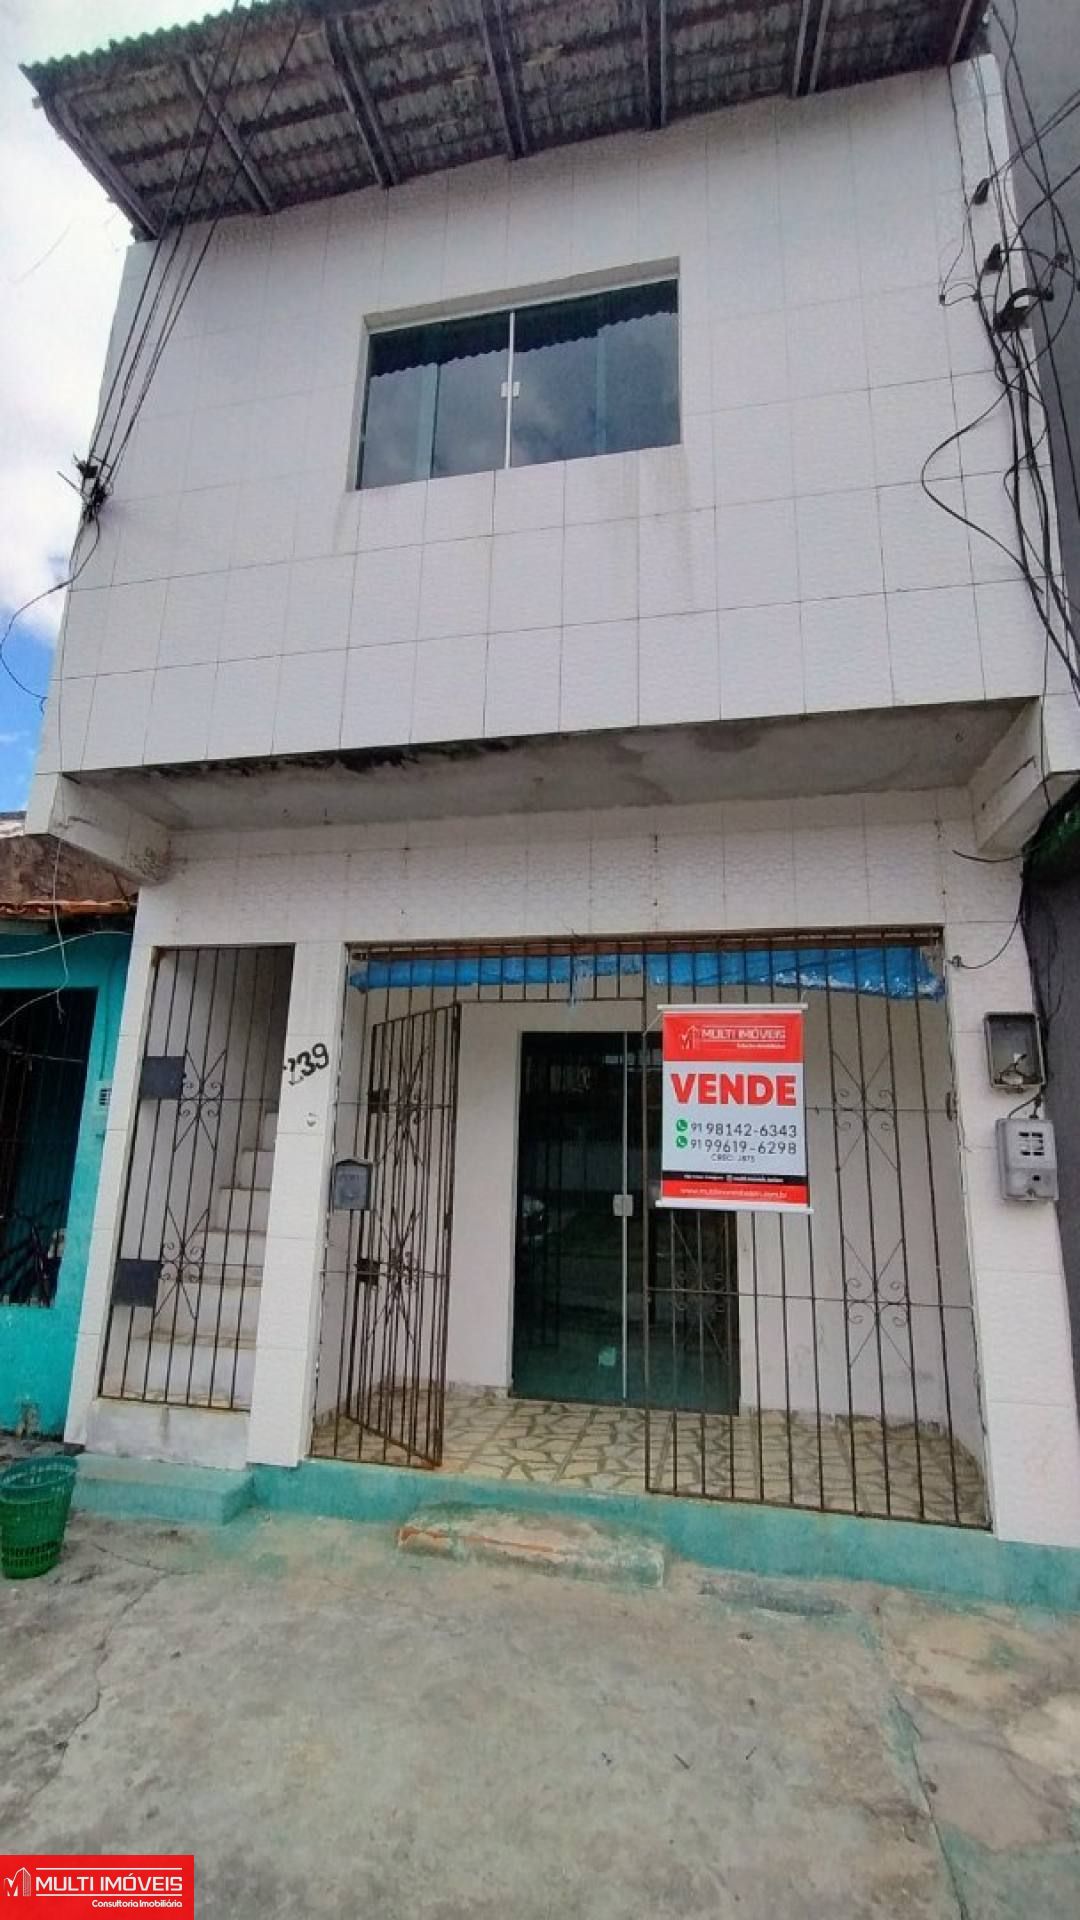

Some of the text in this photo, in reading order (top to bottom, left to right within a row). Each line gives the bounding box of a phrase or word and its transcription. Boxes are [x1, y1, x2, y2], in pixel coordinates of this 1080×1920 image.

[702, 1028, 736, 1040] MULTI
[670, 1073, 797, 1106] VENDE
[690, 1122, 797, 1138] 91 98142-6343
[690, 1139, 797, 1155] 91 99619-6298
